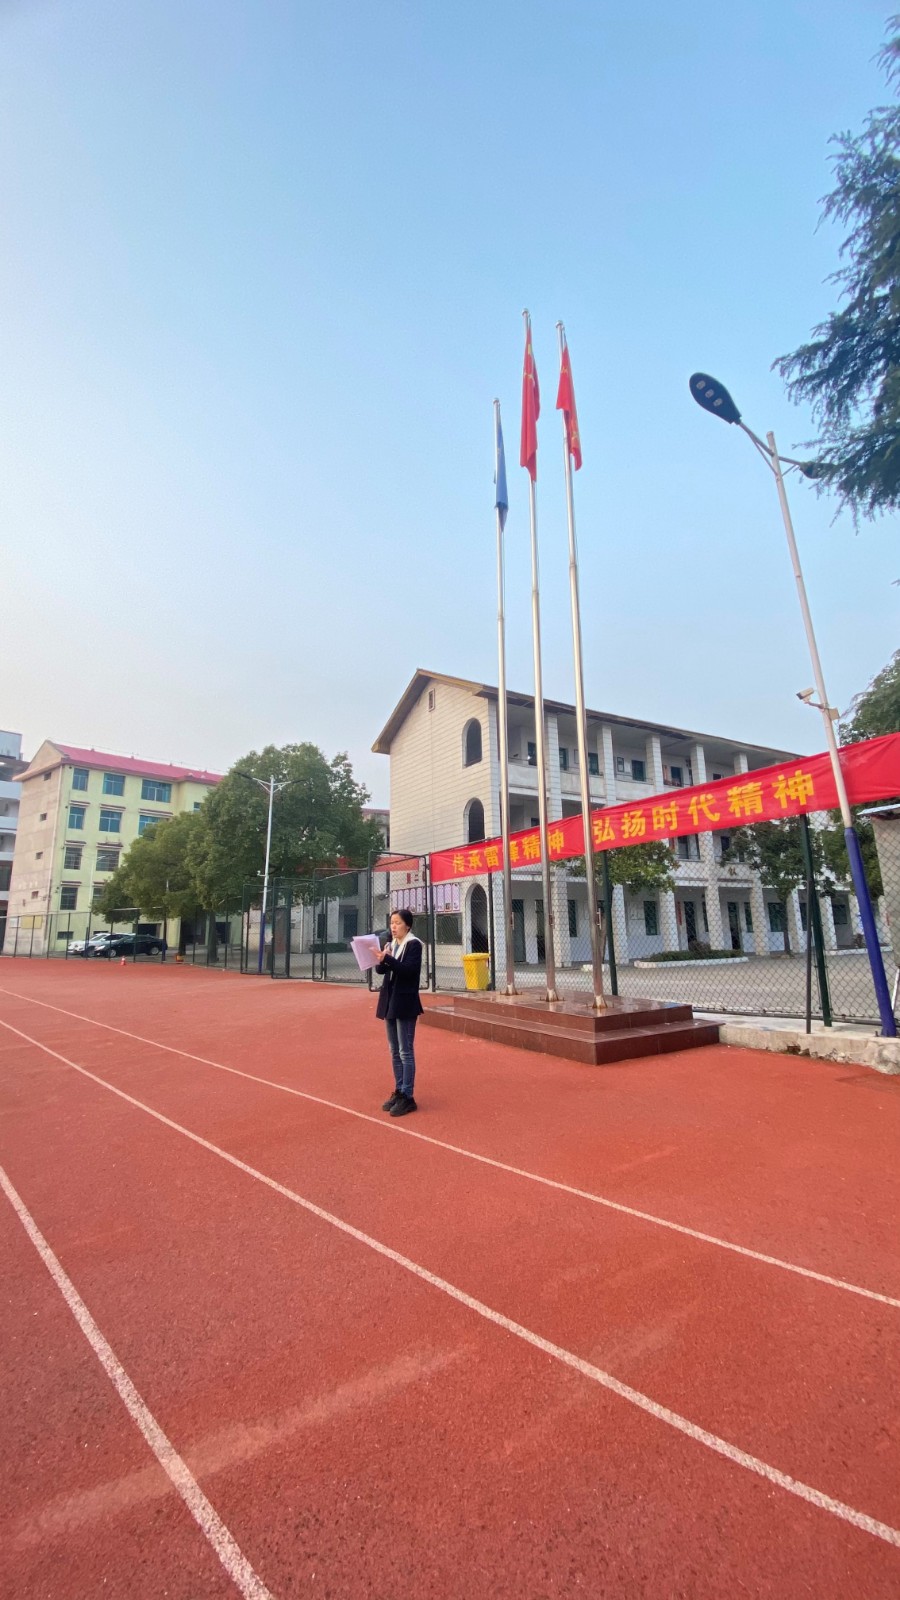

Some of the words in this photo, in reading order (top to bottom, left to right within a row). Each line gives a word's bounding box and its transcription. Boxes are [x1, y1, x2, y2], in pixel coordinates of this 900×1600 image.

[592, 770, 815, 845] 弘扬时代精神
